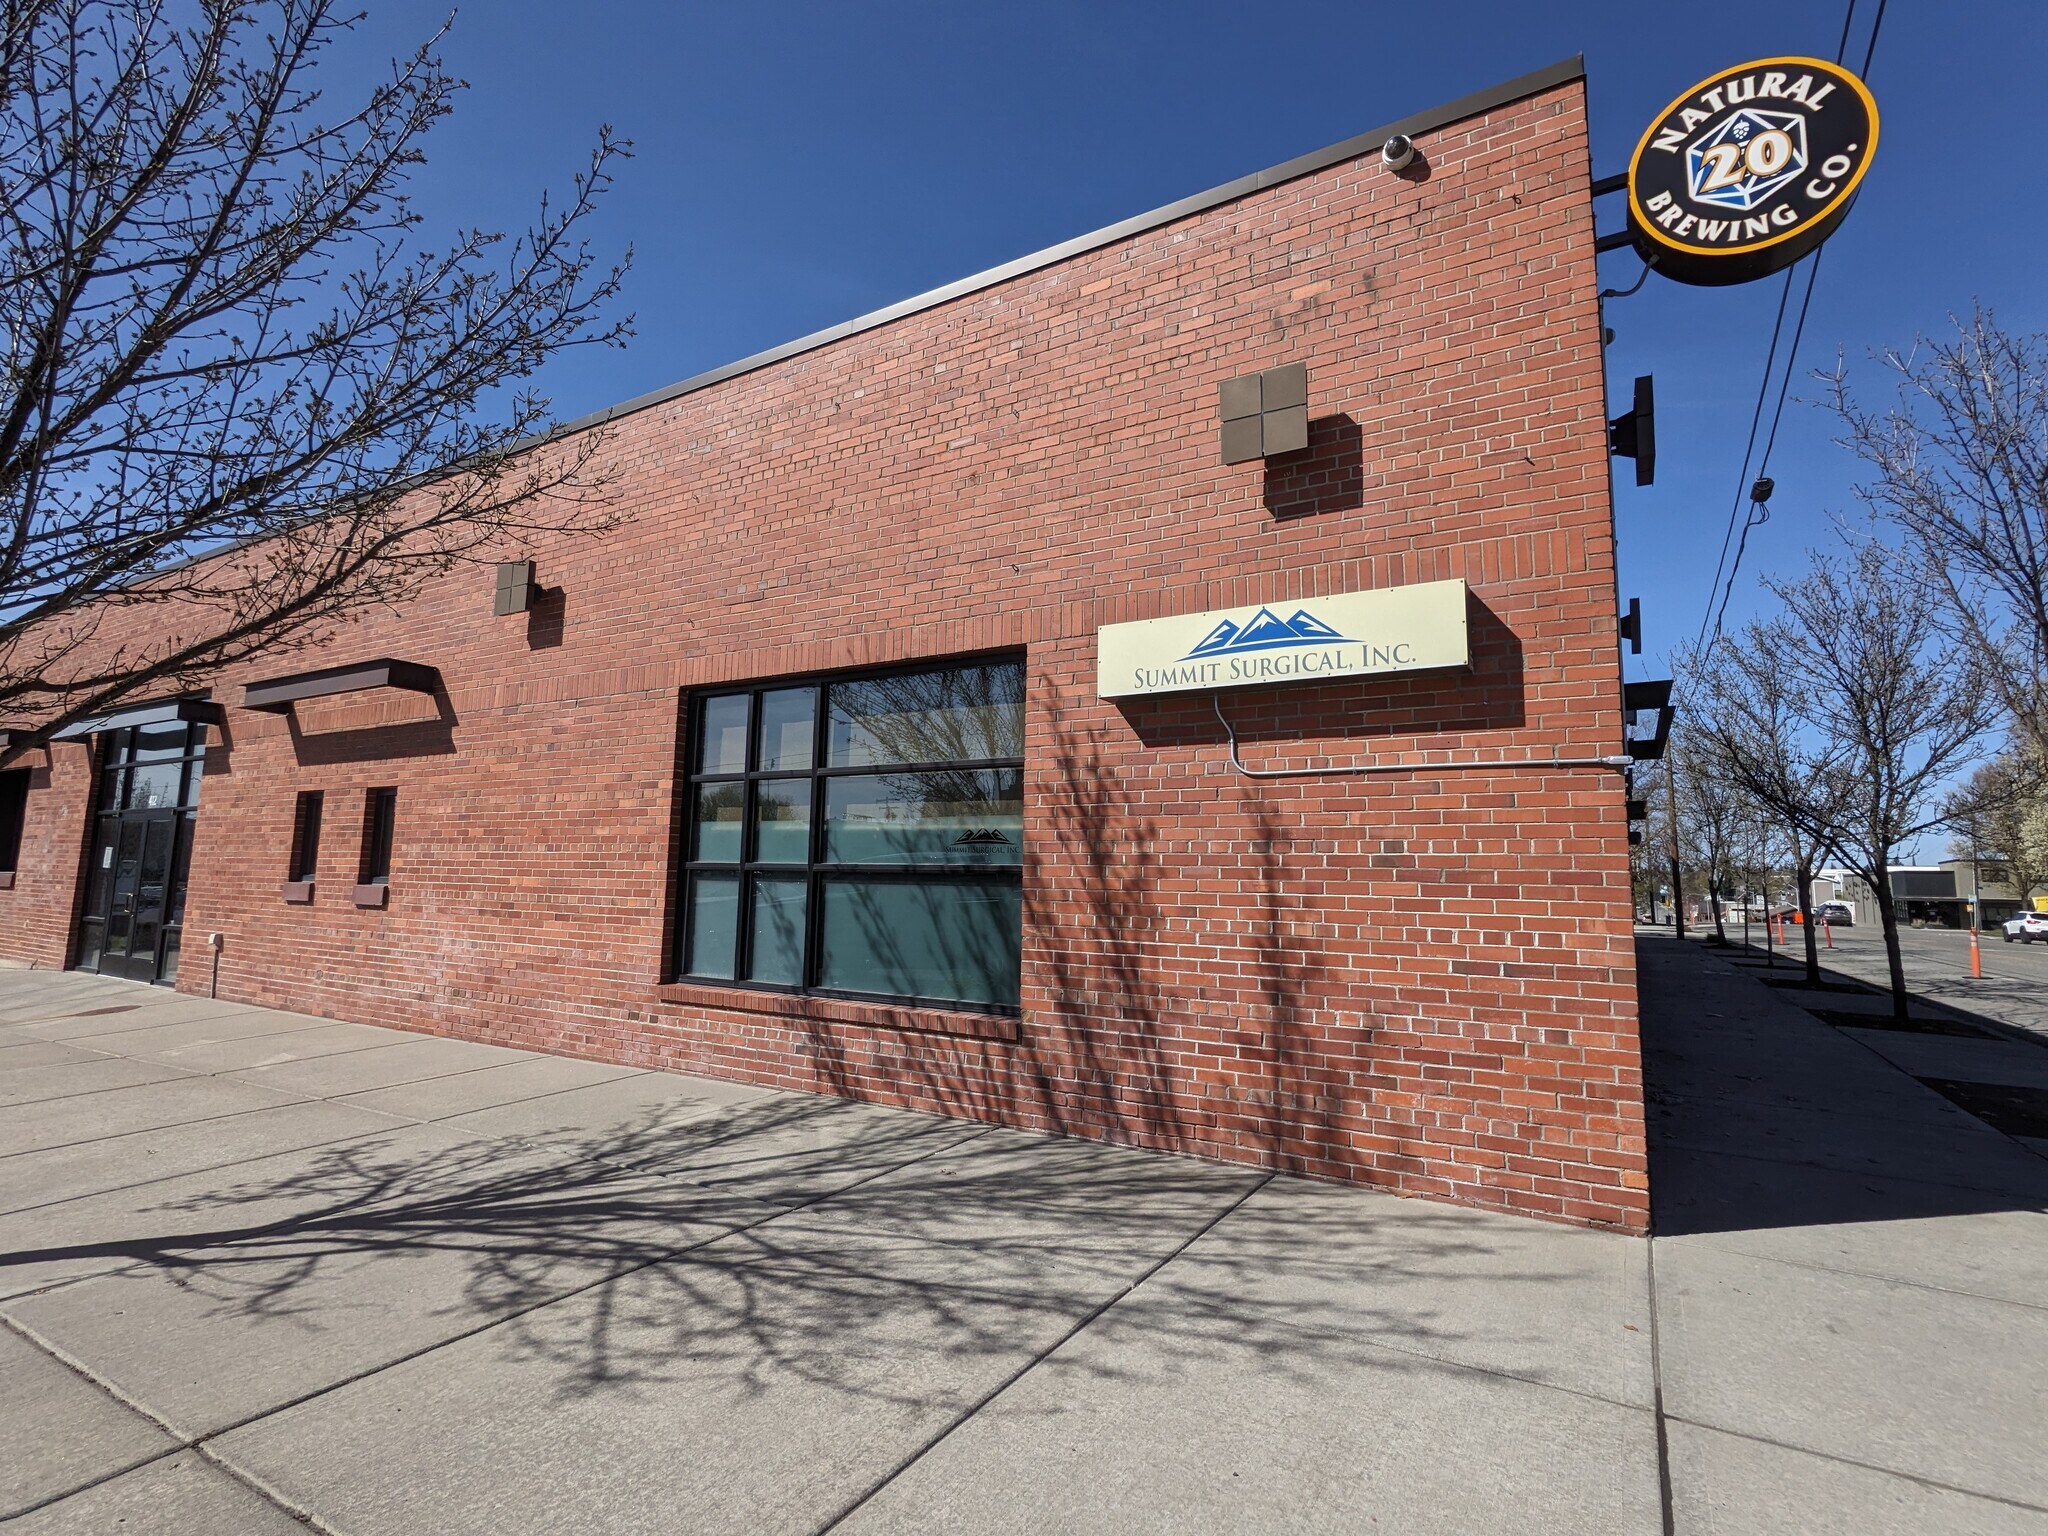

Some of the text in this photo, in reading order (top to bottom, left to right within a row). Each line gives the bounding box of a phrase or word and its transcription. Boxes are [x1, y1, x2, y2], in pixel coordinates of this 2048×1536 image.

[1651, 72, 1836, 154] NATURAL
[1699, 129, 1793, 192] 20
[1646, 143, 1858, 242] BREWING CO.
[1134, 643, 1417, 689] SUMMIT SURGICAL, INC.
[945, 846, 970, 854] SUMMIT
